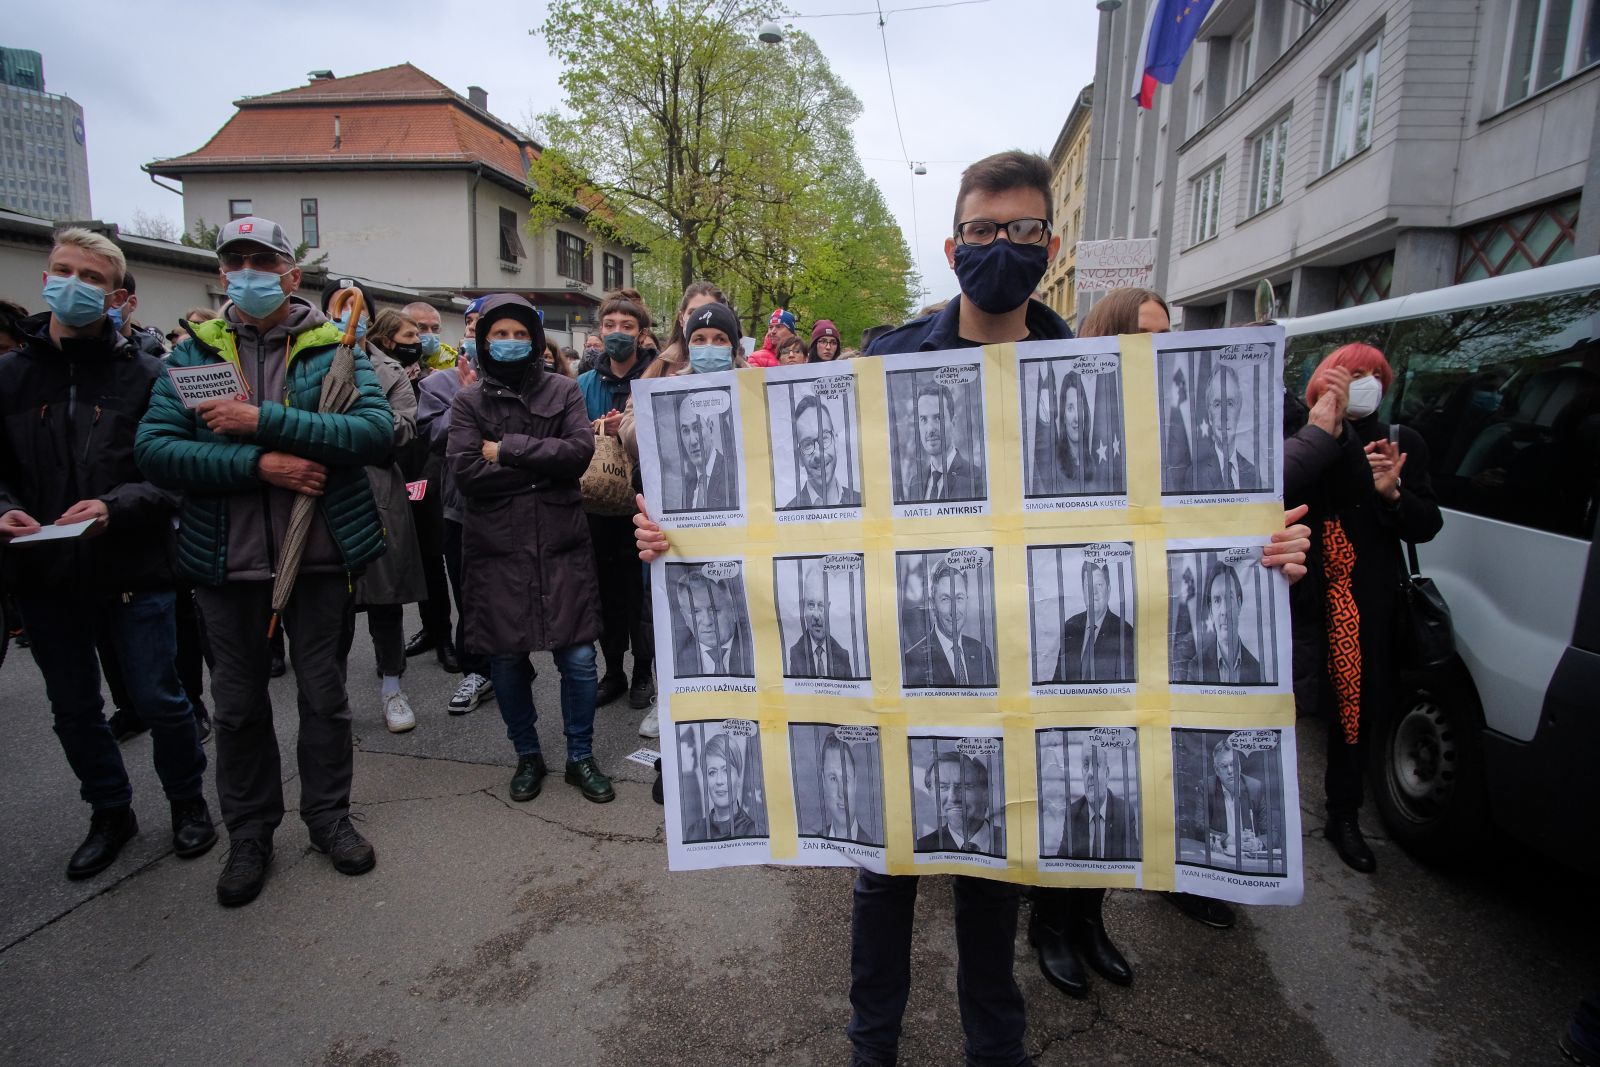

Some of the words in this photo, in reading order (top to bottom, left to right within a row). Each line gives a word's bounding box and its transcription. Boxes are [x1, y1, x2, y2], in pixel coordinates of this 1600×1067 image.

[1224, 345, 1240, 354] KJE
[1245, 344, 1254, 352] JE
[1241, 352, 1269, 361] MAMI?
[176, 371, 232, 383] USTAVIMO
[179, 379, 236, 391] SLOVENSKEGA
[183, 386, 239, 399] PACIENTA!
[904, 508, 932, 517] MATEJ
[937, 505, 983, 515] ANTIKRIST
[1025, 502, 1054, 510] SIMONA
[1055, 500, 1098, 509] NEODRASLA
[778, 513, 805, 522] GREGOR
[806, 512, 838, 520] IZDAJALEC
[674, 684, 713, 694] ZDRAVKO
[714, 682, 757, 693] LAŽIVALŠEK
[1059, 687, 1108, 695] LJUBIMJANŠO
[802, 840, 818, 850] ŽAN
[820, 842, 846, 853] RASIST
[848, 847, 881, 859] MAHNIČ
[1181, 869, 1200, 878] IVAN
[1201, 872, 1225, 882] HRŠAK
[1227, 877, 1281, 888] KOLABORANT
